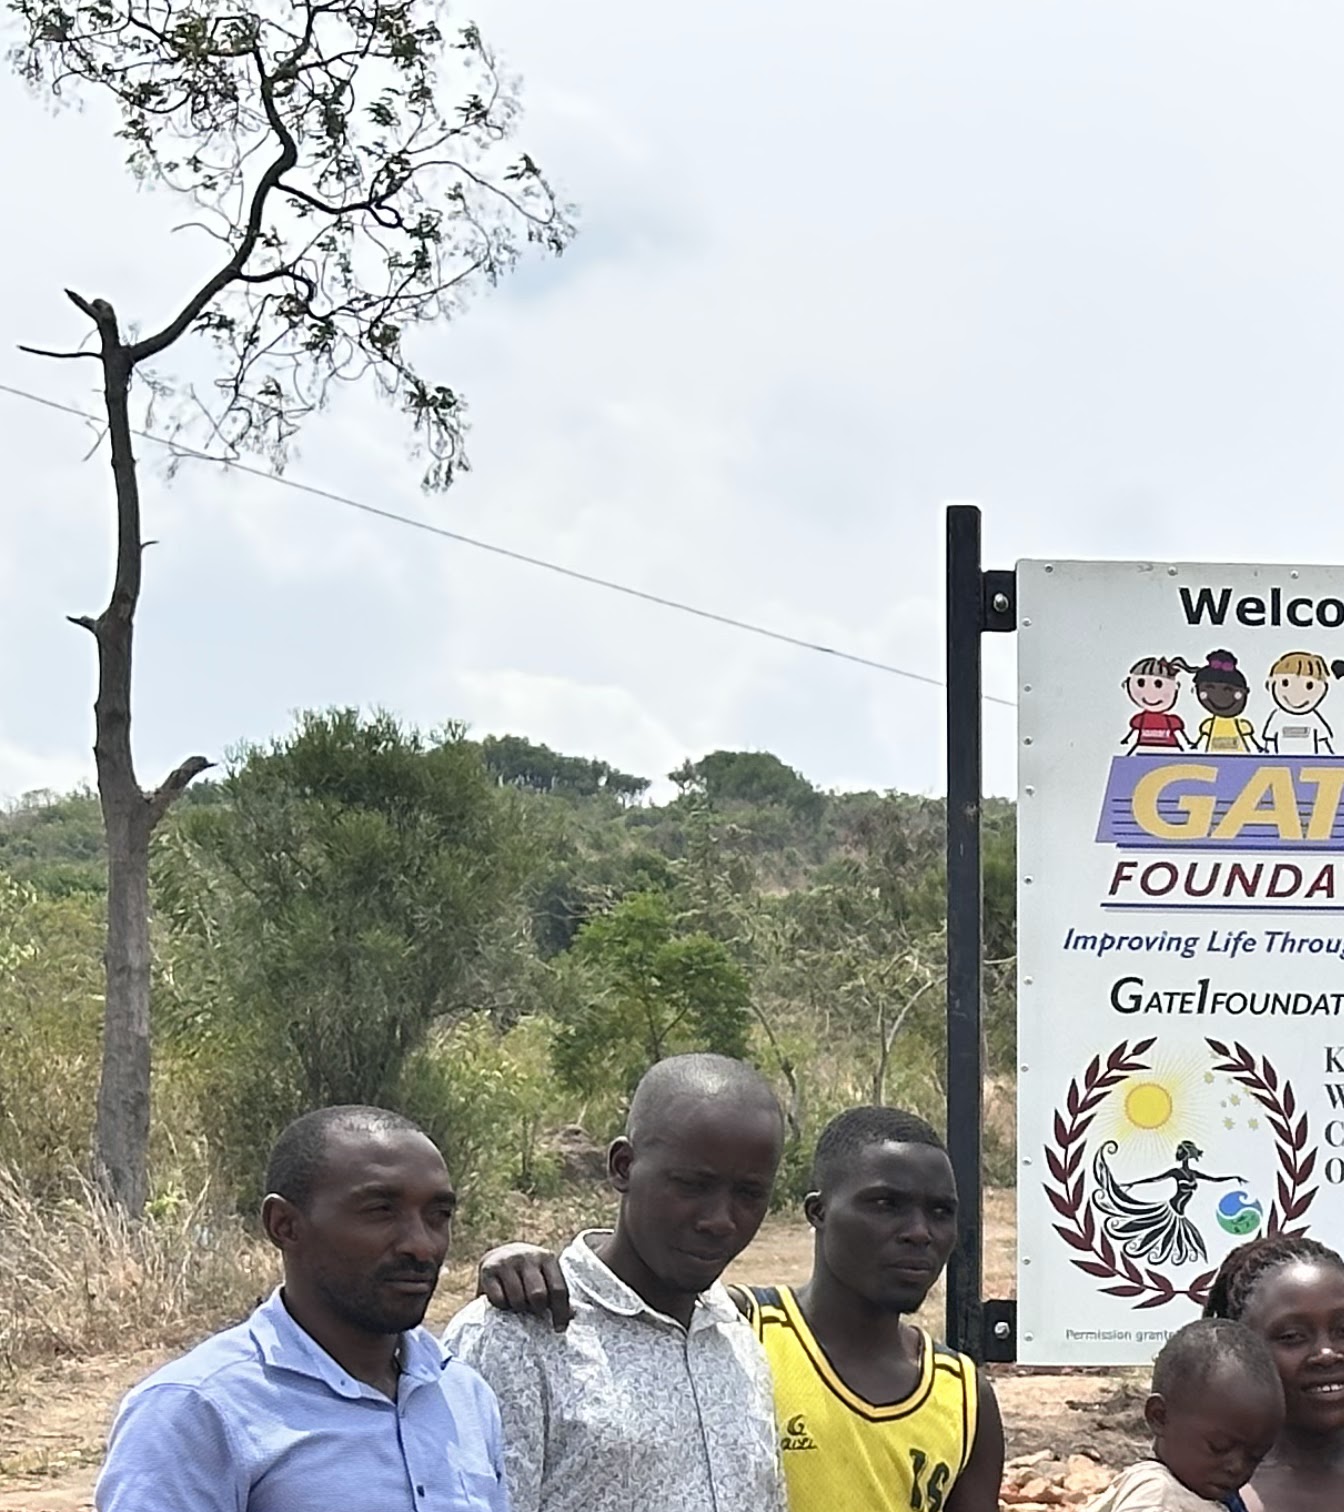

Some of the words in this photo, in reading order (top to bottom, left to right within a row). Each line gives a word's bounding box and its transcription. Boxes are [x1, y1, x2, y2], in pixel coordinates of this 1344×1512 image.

[1063, 927, 1199, 958] Improving
[1207, 929, 1257, 958] Life
[1066, 1329, 1131, 1340] Permission
